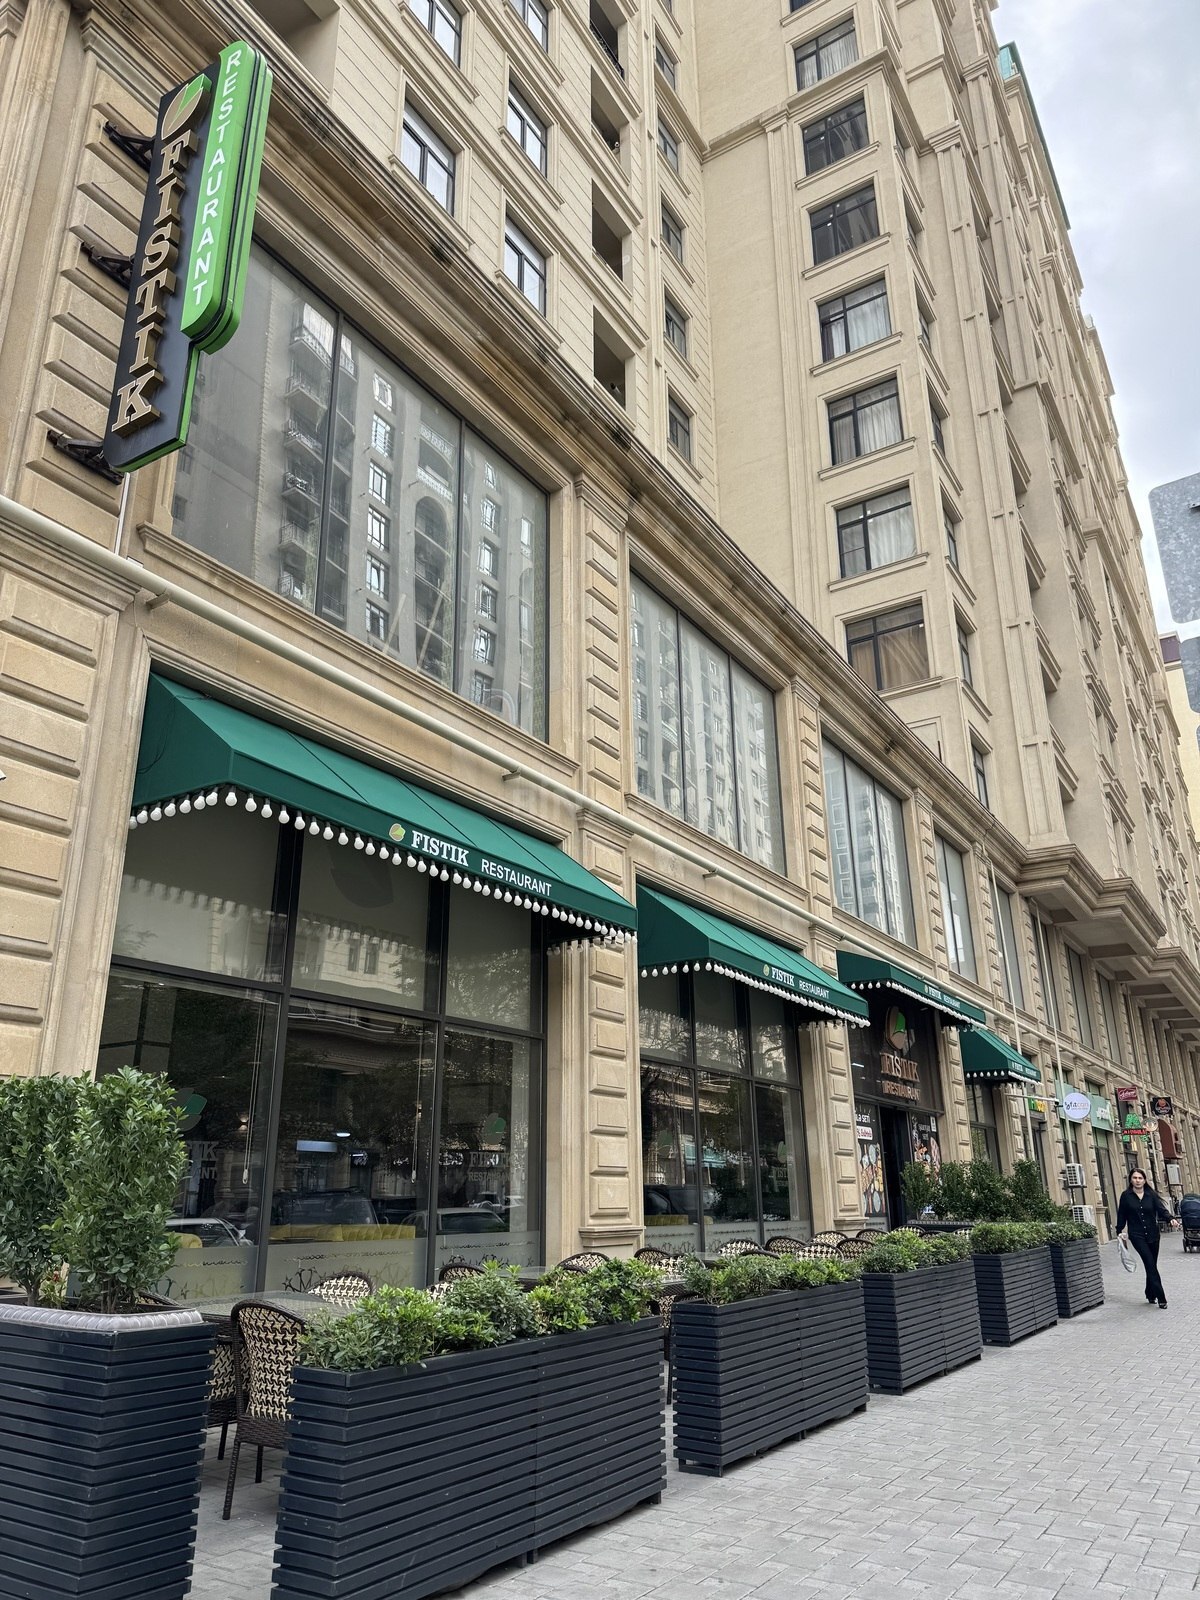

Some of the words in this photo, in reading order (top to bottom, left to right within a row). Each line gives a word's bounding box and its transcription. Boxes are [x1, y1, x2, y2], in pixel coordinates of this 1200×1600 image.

[192, 49, 242, 306] RESTAURANT
[111, 129, 198, 438] FISTIK
[410, 830, 470, 867] FISTIK
[481, 858, 552, 897] RESTAURANT
[771, 966, 795, 986] FISTIK
[799, 979, 830, 1000] RESTAURANT
[879, 1052, 920, 1083] FISTIK
